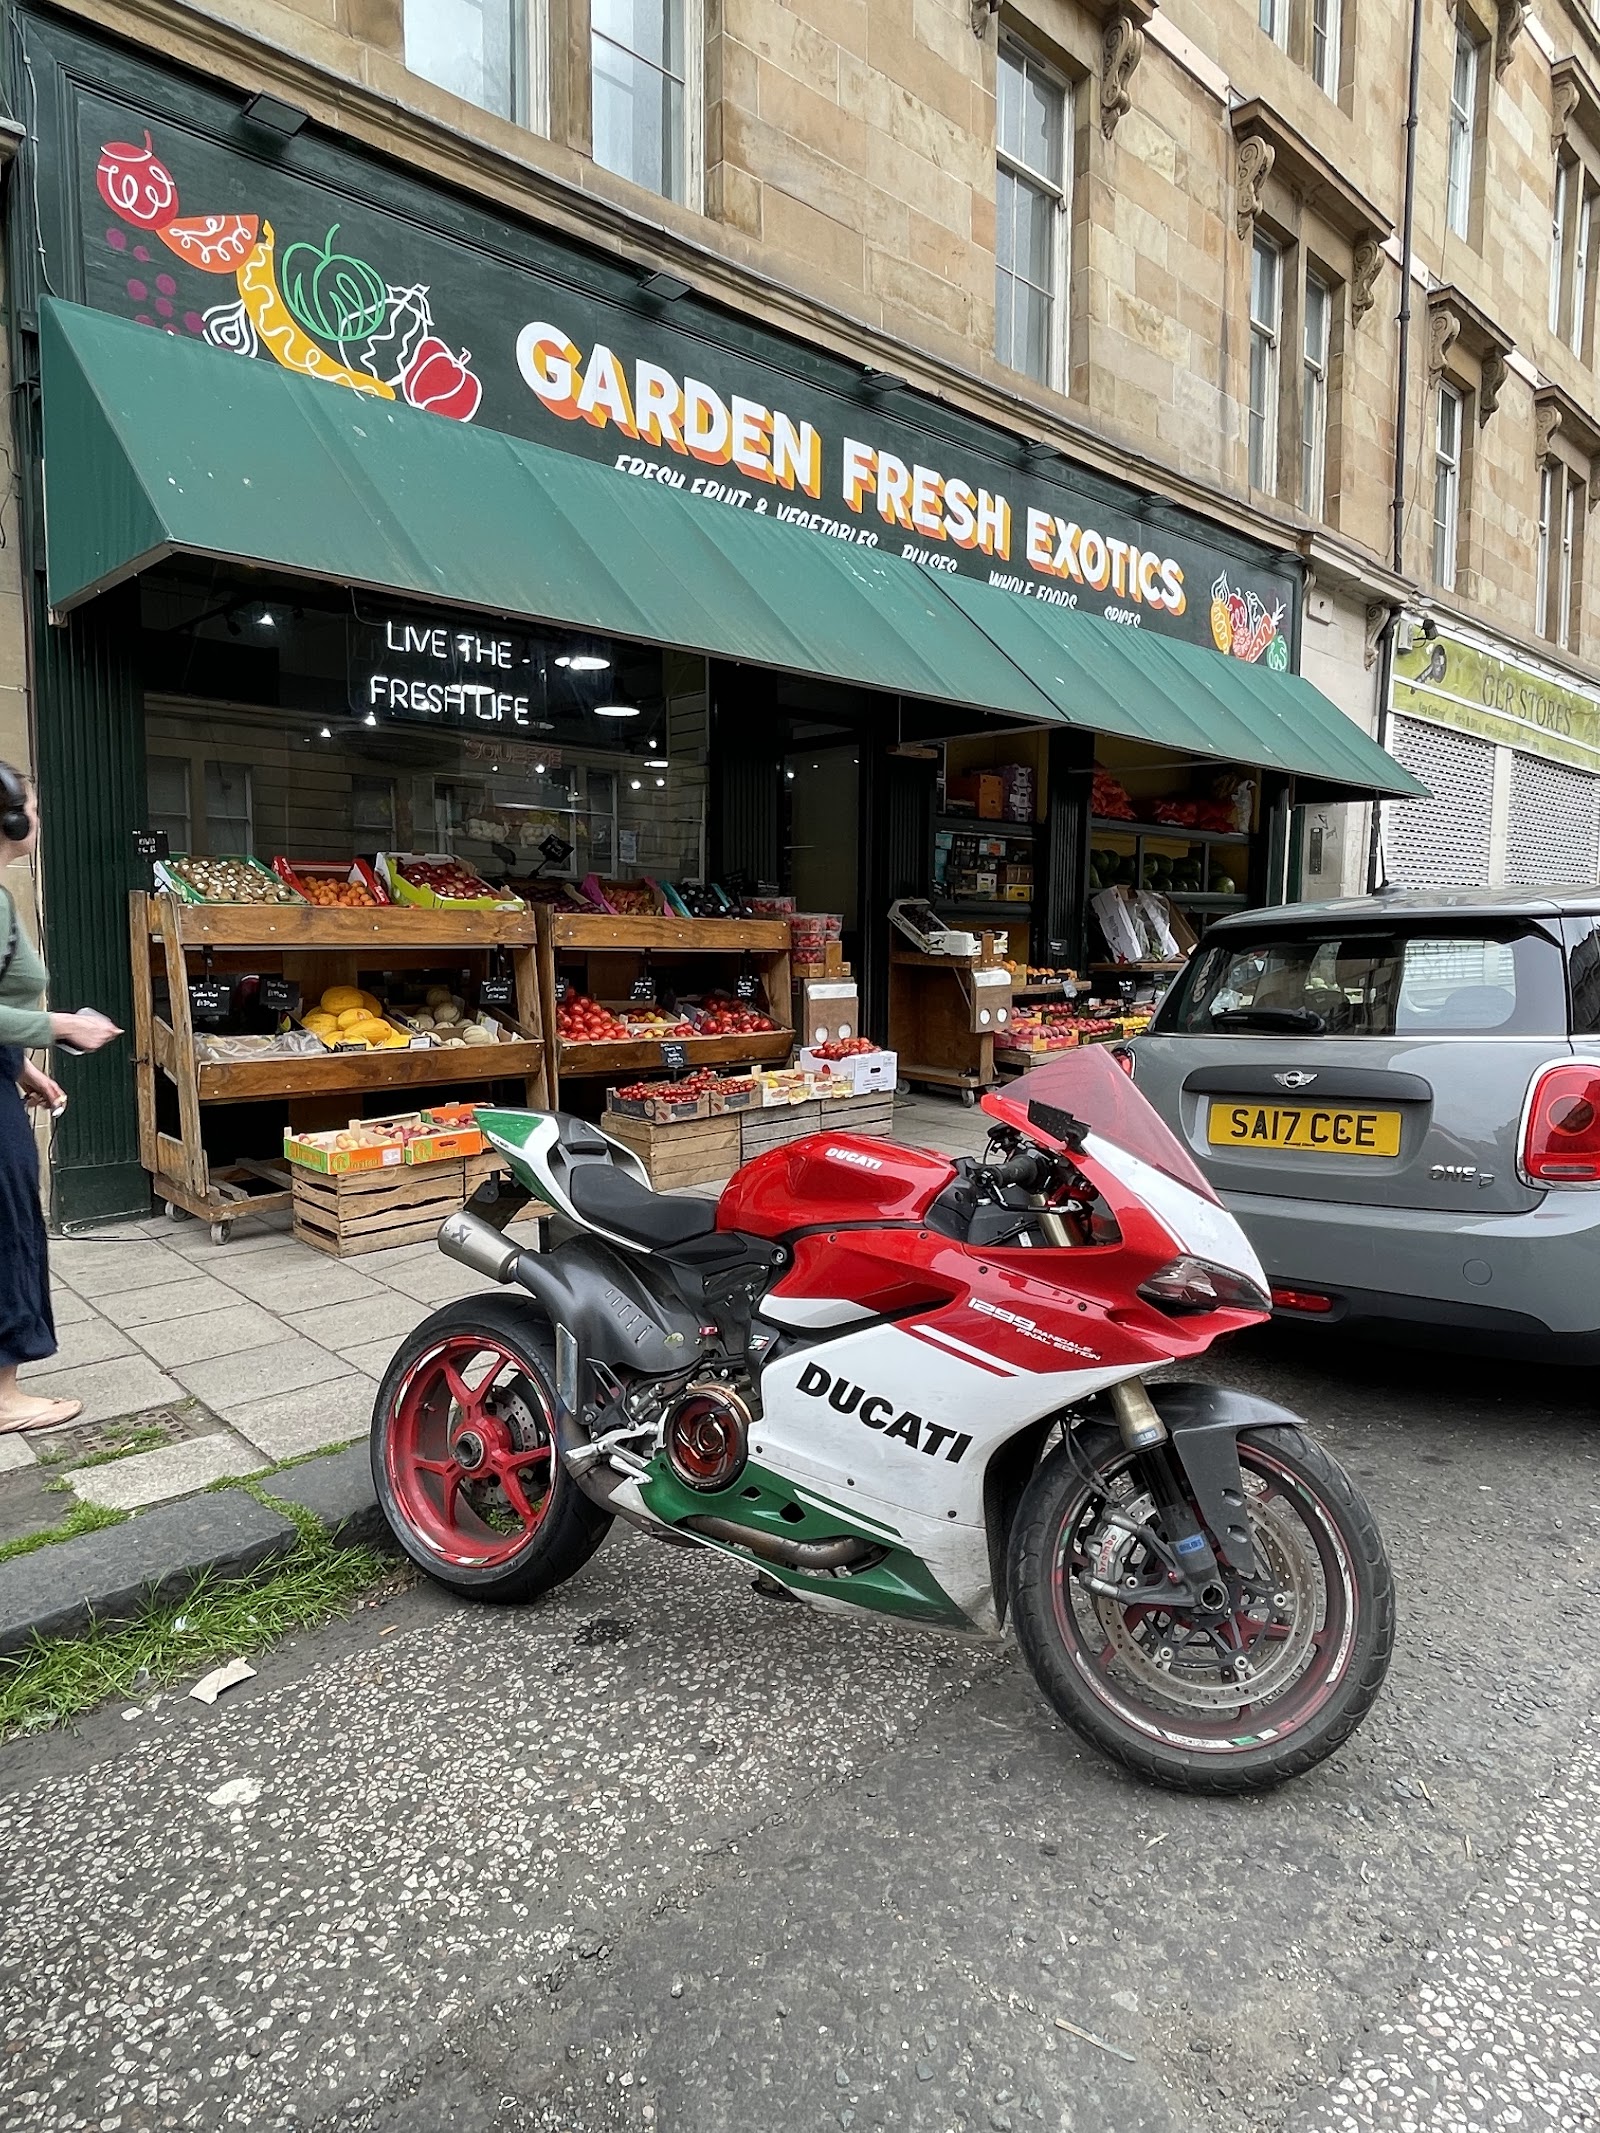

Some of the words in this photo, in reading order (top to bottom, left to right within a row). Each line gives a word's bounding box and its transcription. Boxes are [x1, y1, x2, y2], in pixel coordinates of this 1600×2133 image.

[516, 321, 822, 500] GARDEN
[842, 437, 1011, 562] FRESH
[1026, 505, 1187, 617] EXOTICS
[387, 620, 448, 659] LIVE
[456, 633, 512, 669] THE
[369, 675, 465, 715] FRESH
[475, 690, 530, 726] LIFE
[1519, 688, 1572, 736] STORES
[1230, 1109, 1301, 1143] SA17
[1310, 1113, 1378, 1147] CCE
[825, 1147, 883, 1170] DUCATI
[1429, 1164, 1477, 1183] ONE
[967, 1297, 1036, 1331] 1299
[1032, 1328, 1094, 1352] PANIGALE
[1016, 1327, 1051, 1345] FINAL
[1053, 1342, 1101, 1361] EDITION
[796, 1361, 974, 1464] DUCATI
[1098, 1534, 1117, 1573] brembo
